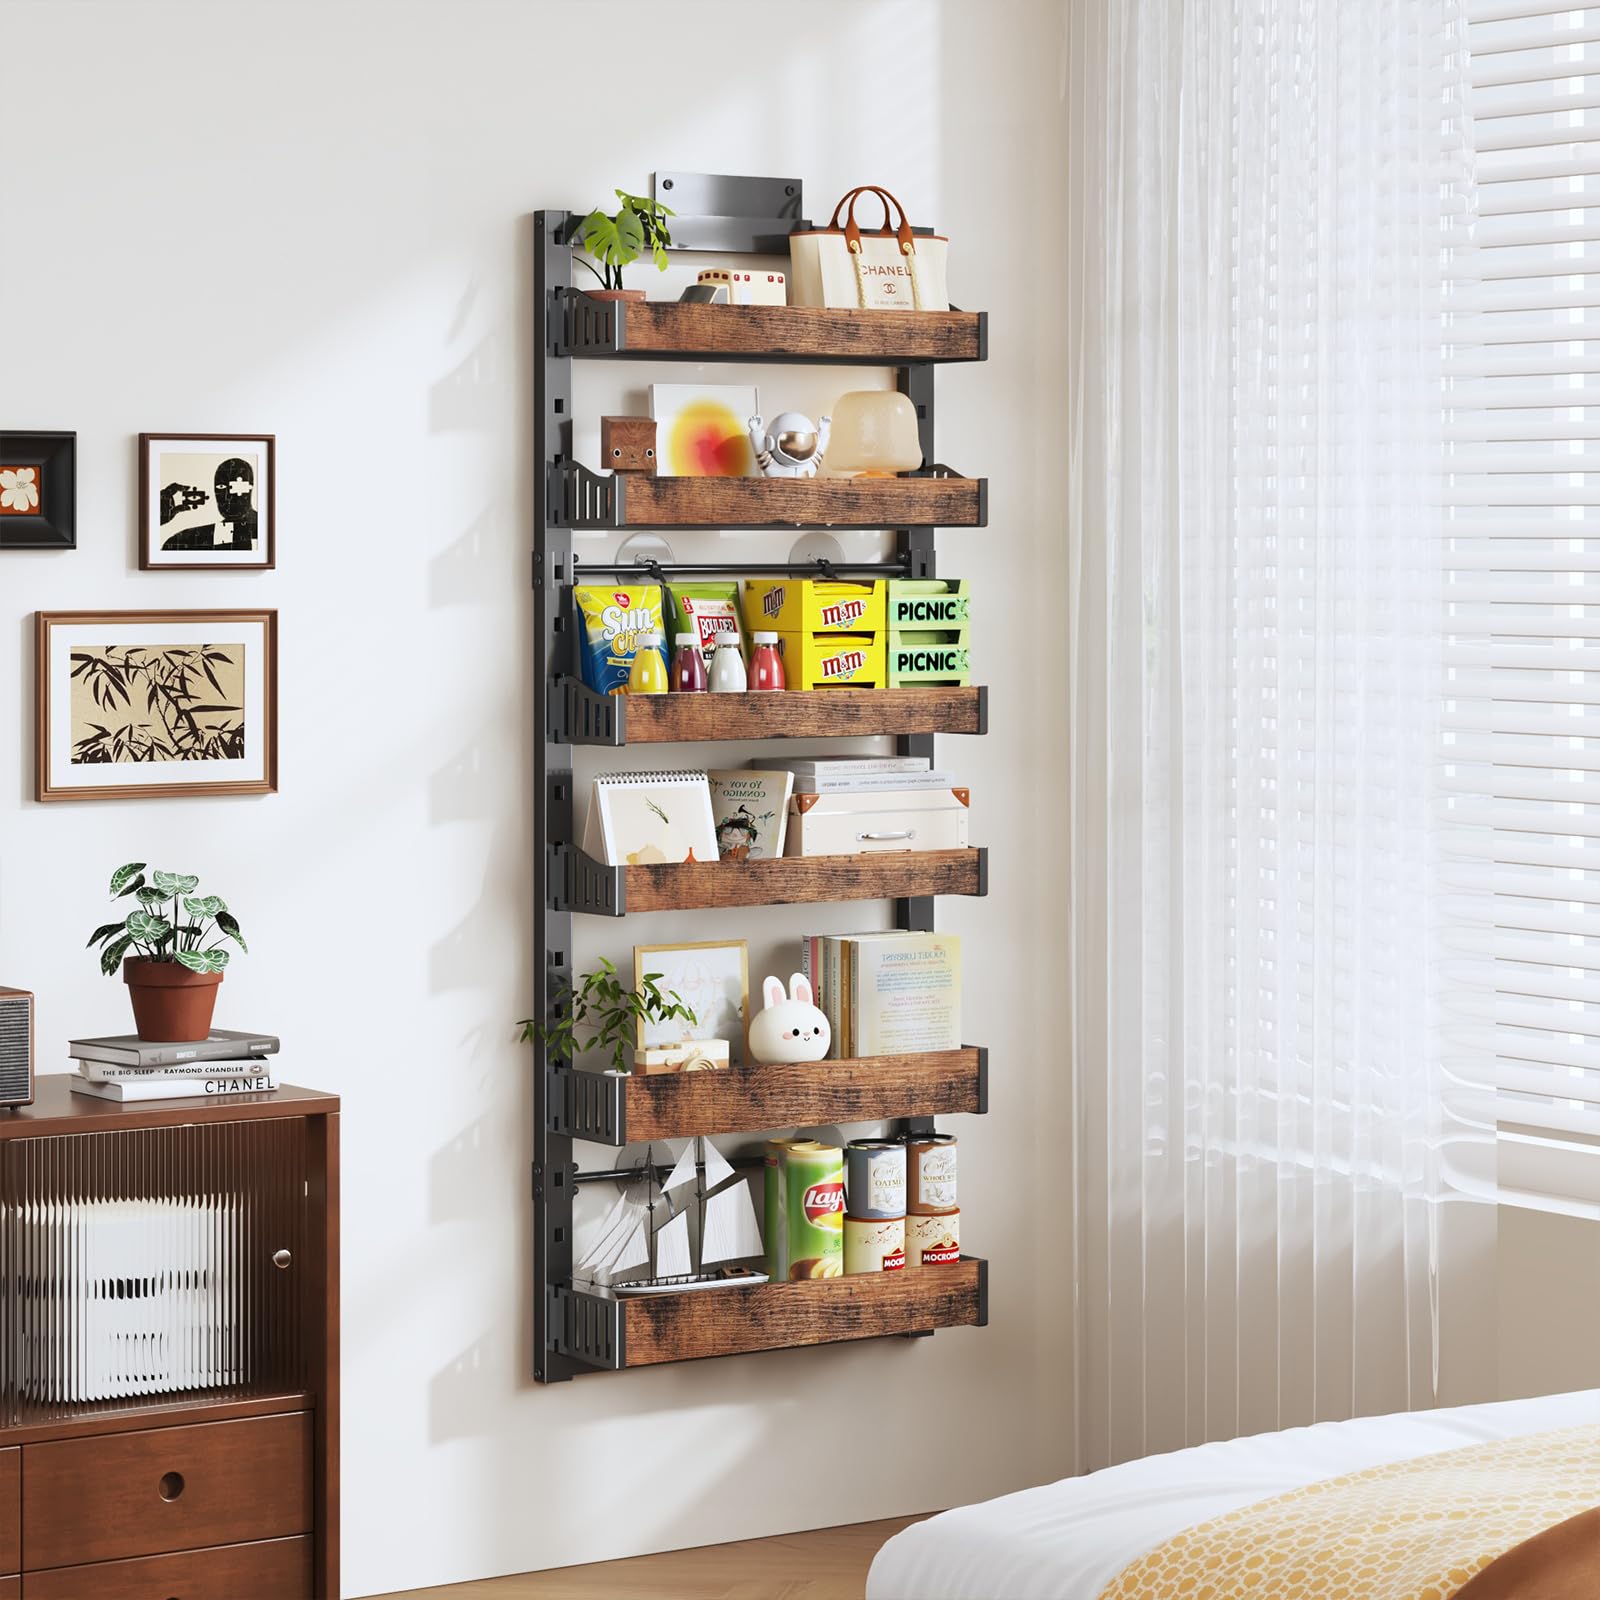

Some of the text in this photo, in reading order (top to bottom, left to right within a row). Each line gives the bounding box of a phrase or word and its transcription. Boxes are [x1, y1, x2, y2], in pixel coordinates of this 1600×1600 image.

[862, 265, 912, 277] CHANEL
[898, 602, 956, 621] PICNIC
[602, 606, 654, 641] Sun
[699, 617, 735, 639] BOULDER
[898, 652, 956, 672] PICNIC
[164, 1067, 203, 1075] RAYMOND
[205, 1066, 244, 1074] CHANDLER
[205, 1077, 275, 1093] CHANEL
